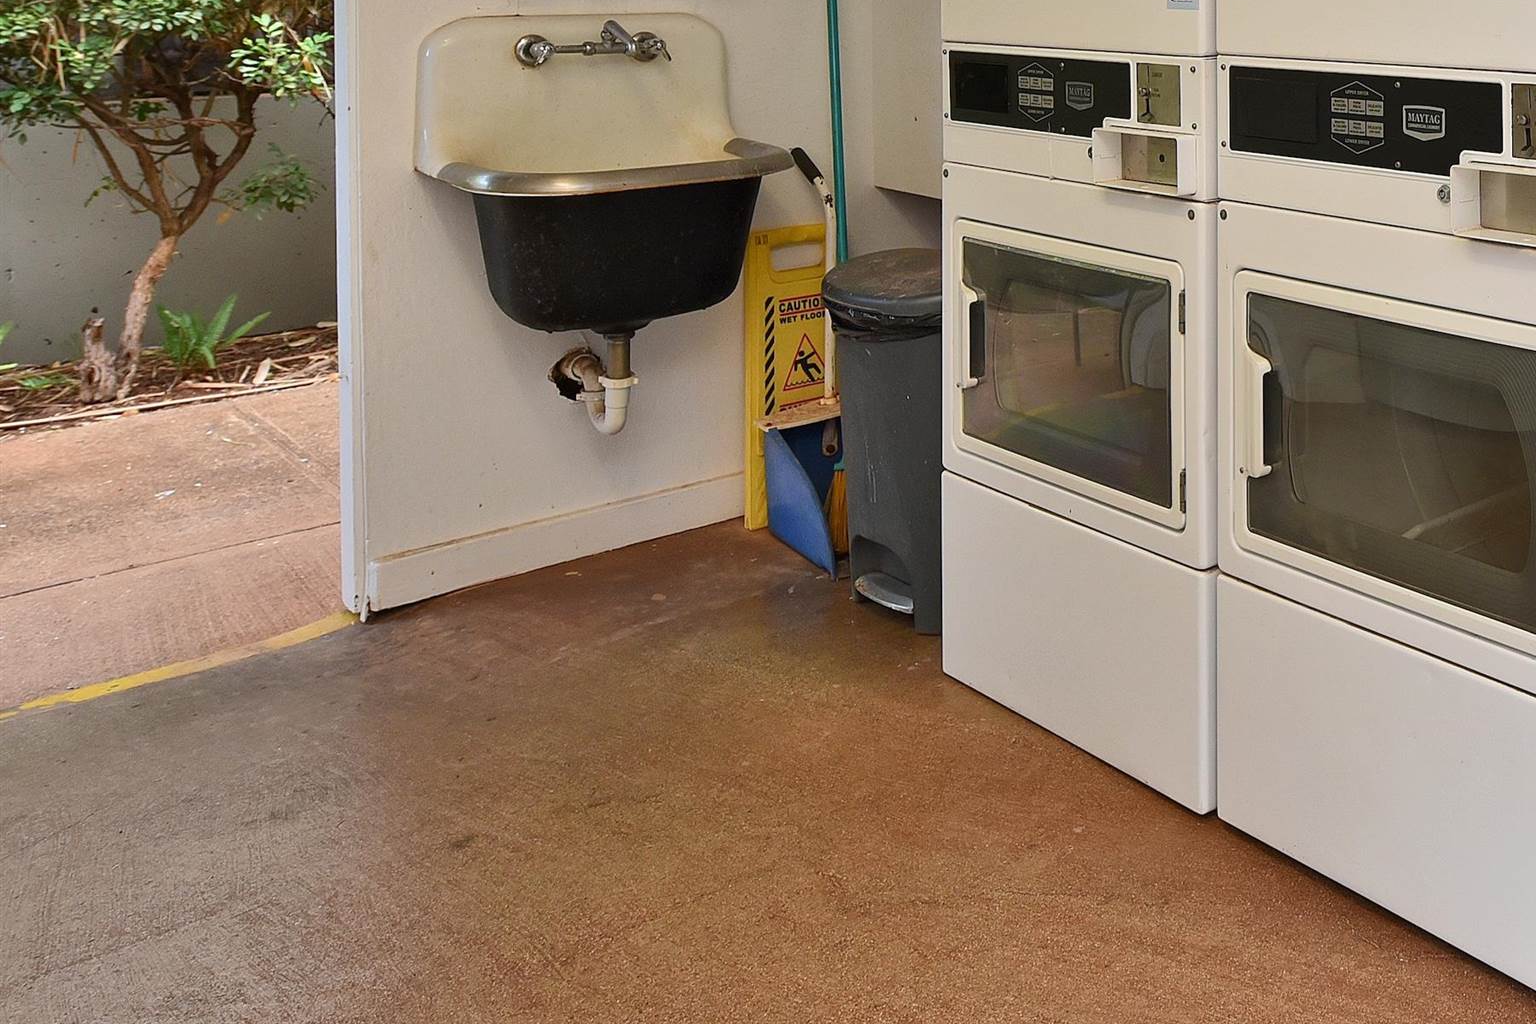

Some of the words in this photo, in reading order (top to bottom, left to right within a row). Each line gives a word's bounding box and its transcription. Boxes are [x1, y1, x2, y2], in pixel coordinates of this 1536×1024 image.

[1406, 112, 1441, 126] MAYTAG
[778, 297, 821, 313] CAUTIO
[778, 314, 798, 325] WET
